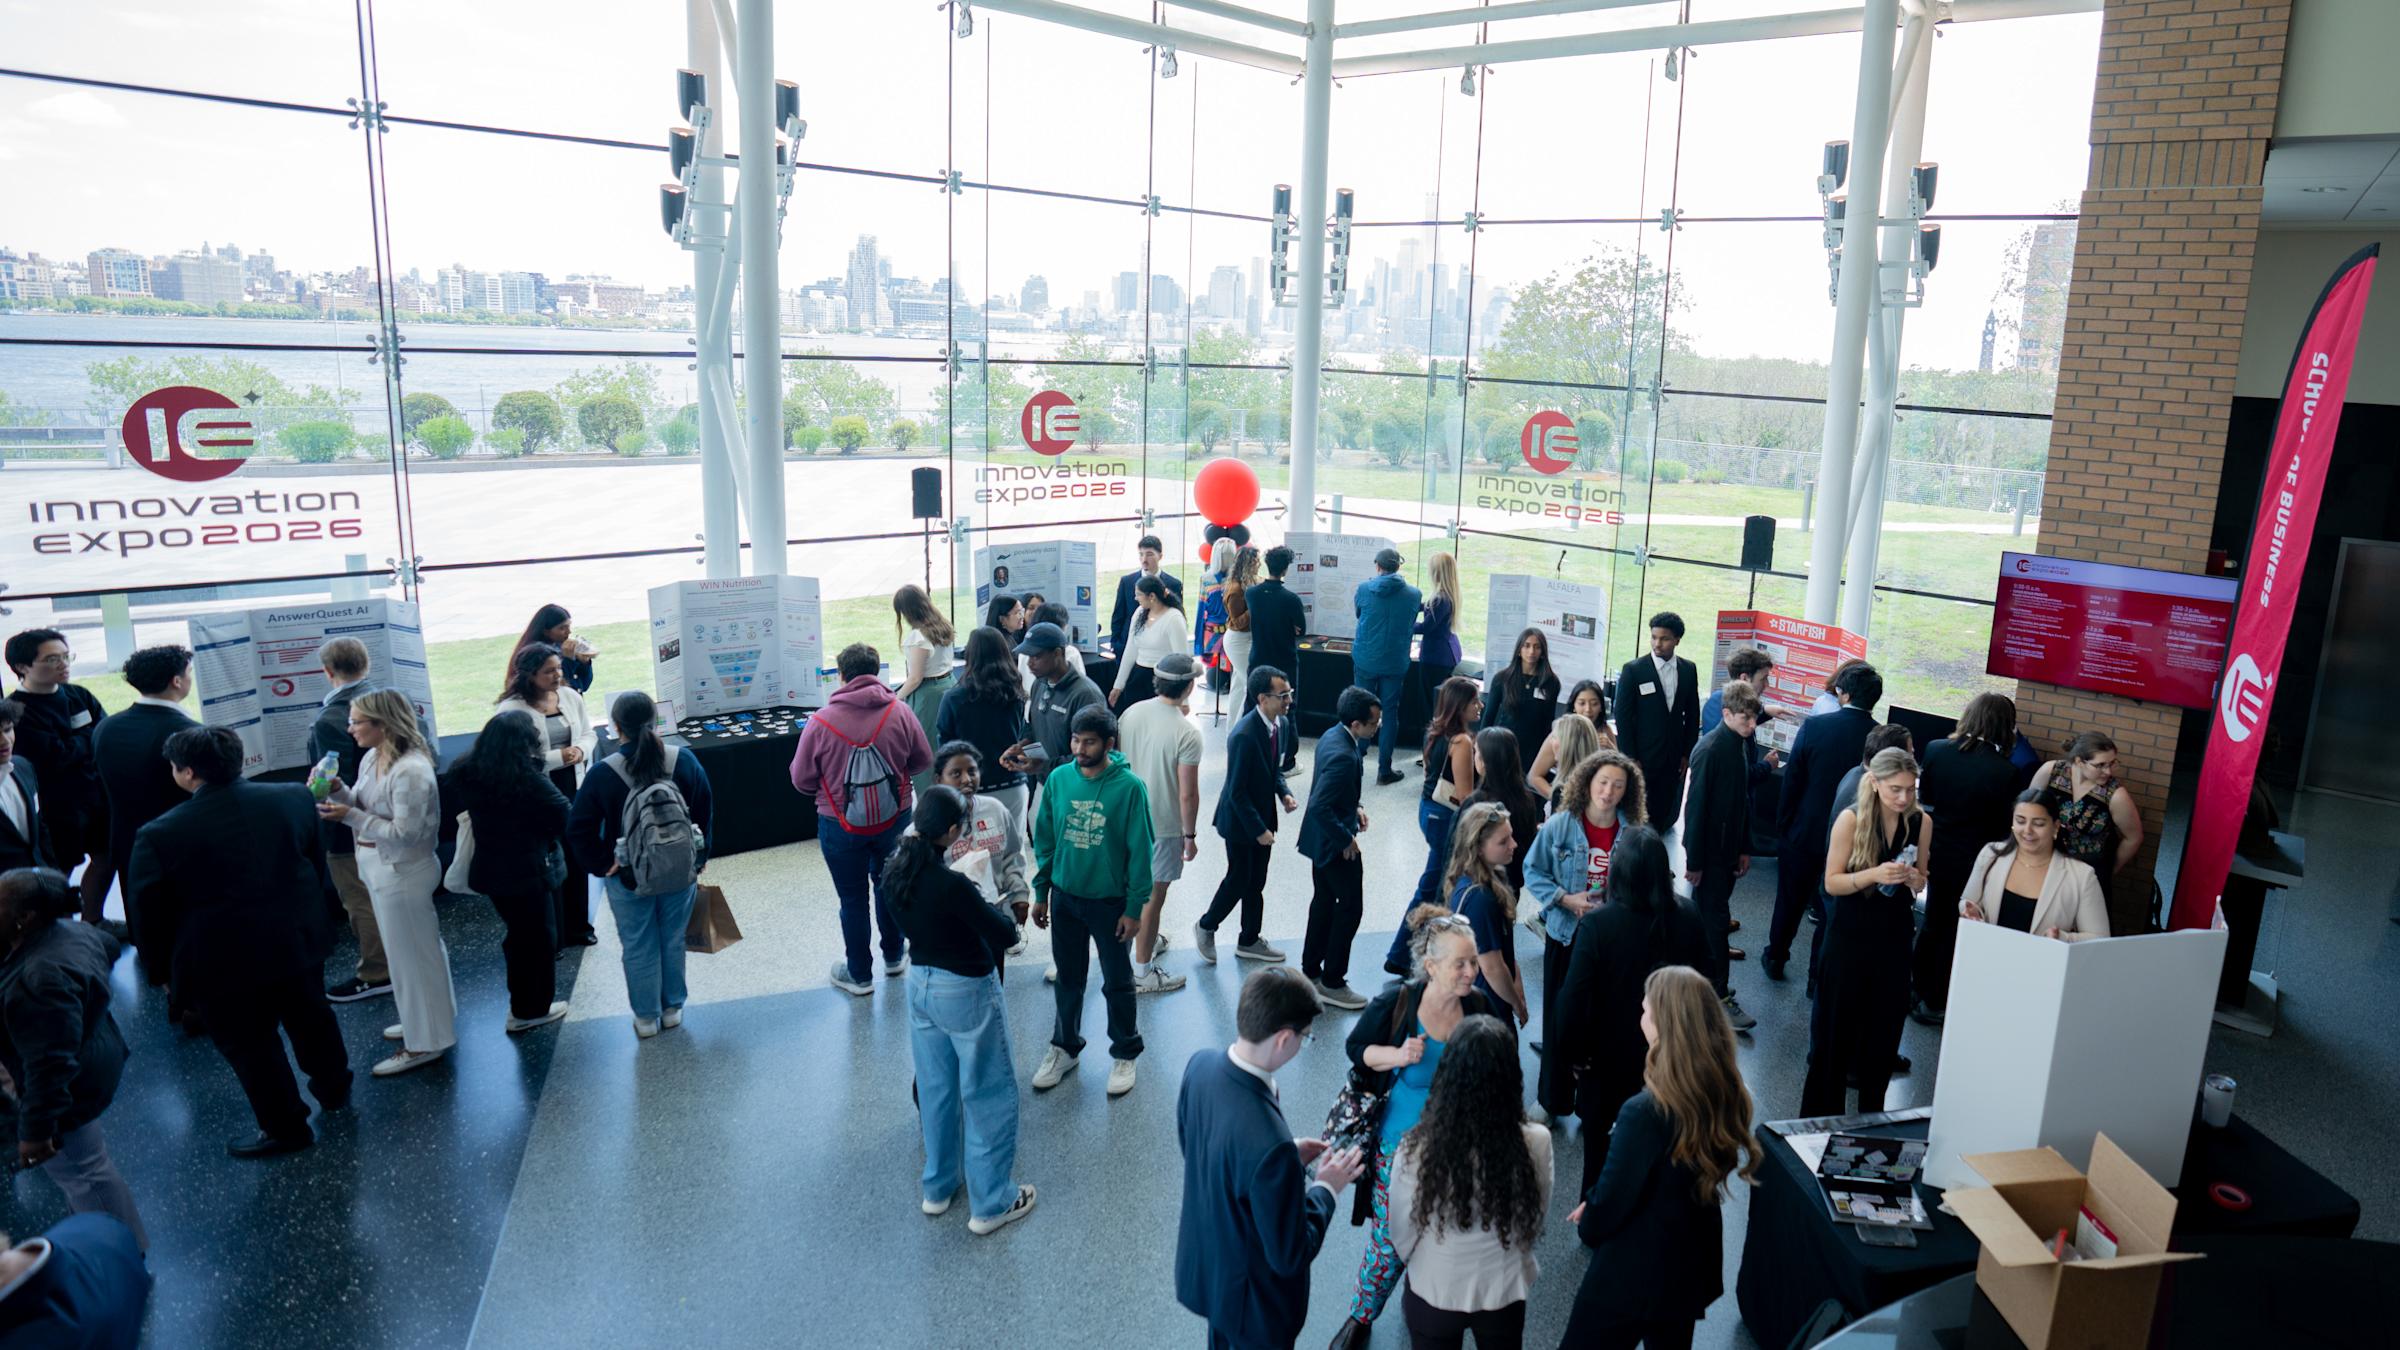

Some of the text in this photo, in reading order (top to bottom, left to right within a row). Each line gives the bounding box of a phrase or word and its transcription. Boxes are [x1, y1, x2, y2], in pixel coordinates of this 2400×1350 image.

[2301, 352, 2329, 443] SCHO
[2260, 490, 2293, 607] BUSINESS
[699, 577, 762, 591] WIN Nutrition
[1546, 581, 1582, 594] ALFALFA
[267, 607, 353, 624] AnswerQuest
[355, 605, 369, 616] AI
[1778, 619, 1827, 641] STARFISH
[245, 753, 263, 767] ENS
